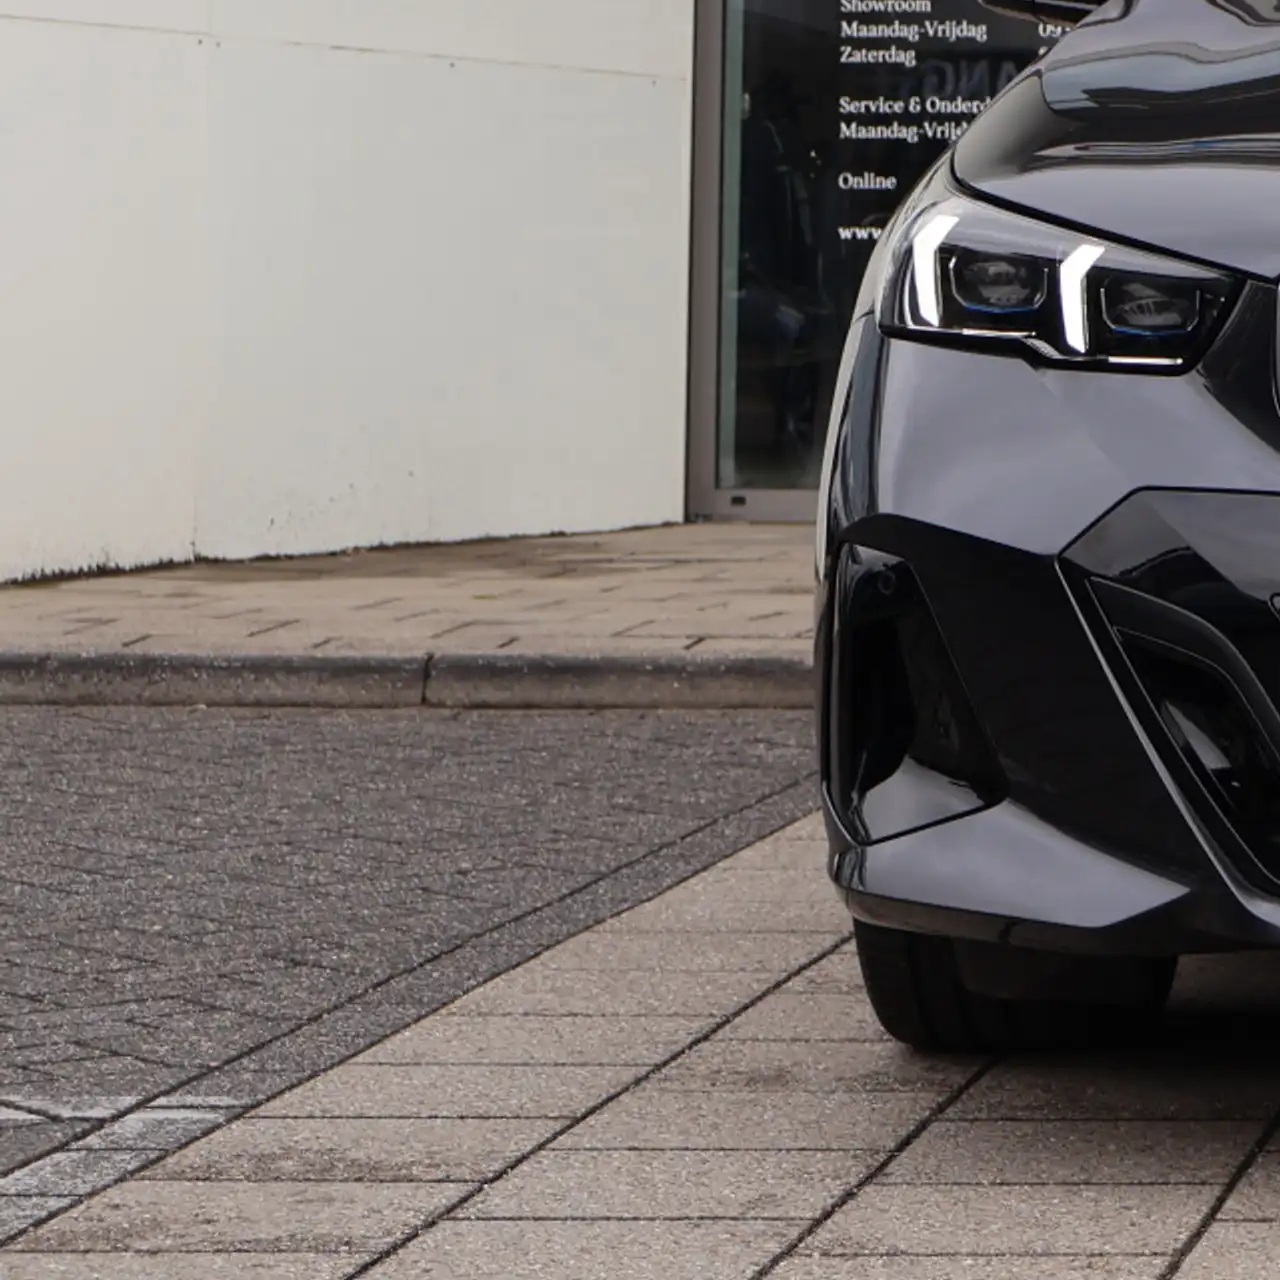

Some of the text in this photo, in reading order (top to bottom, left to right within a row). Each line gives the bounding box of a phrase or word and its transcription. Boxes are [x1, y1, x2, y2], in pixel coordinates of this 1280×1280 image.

[841, 21, 988, 42] Maandag-Vrijdag
[840, 46, 917, 66] Zaterdag
[839, 96, 905, 114] Service
[908, 97, 922, 114] &
[838, 172, 897, 190] Online
